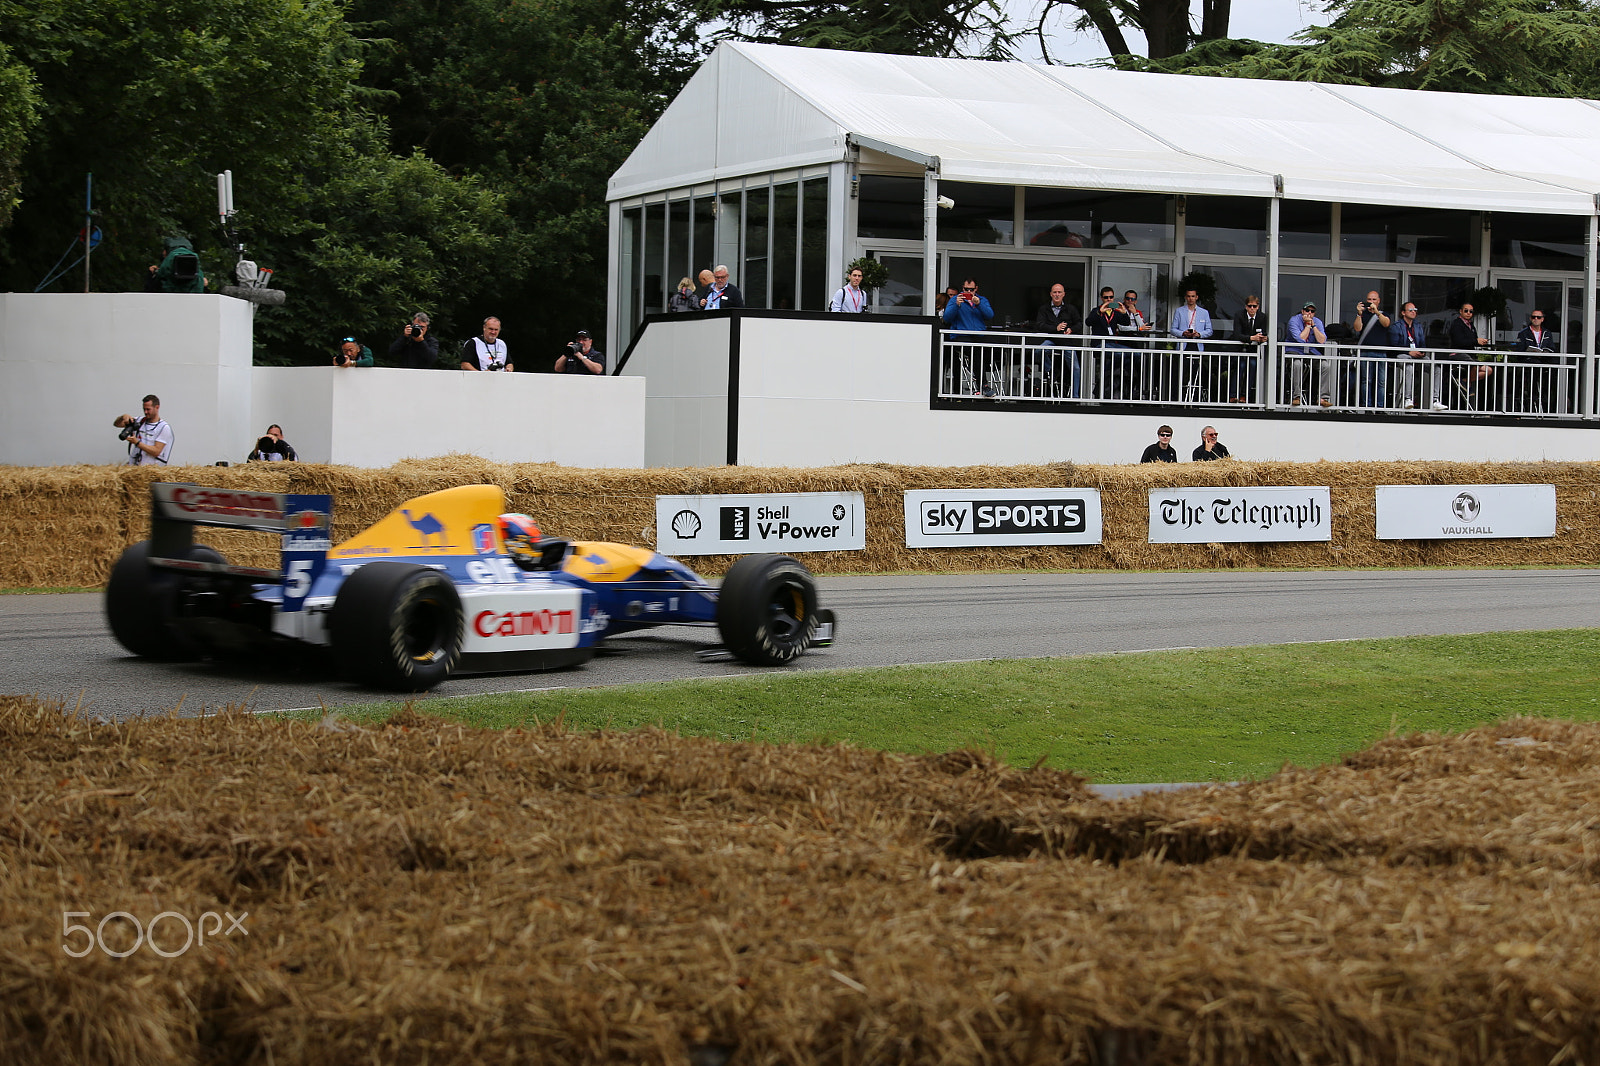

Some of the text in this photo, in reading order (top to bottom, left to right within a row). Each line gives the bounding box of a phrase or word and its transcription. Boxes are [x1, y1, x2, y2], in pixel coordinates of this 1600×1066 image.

[734, 508, 745, 538] NEW
[757, 505, 789, 520] Shell
[926, 503, 1081, 532] sky SPORTS
[1159, 497, 1322, 530] The Telegraph
[757, 522, 840, 540] V-Power
[1441, 526, 1493, 535] VAUXHALL
[285, 560, 314, 598] 5
[465, 557, 520, 584] elf
[473, 608, 576, 638] Canon
